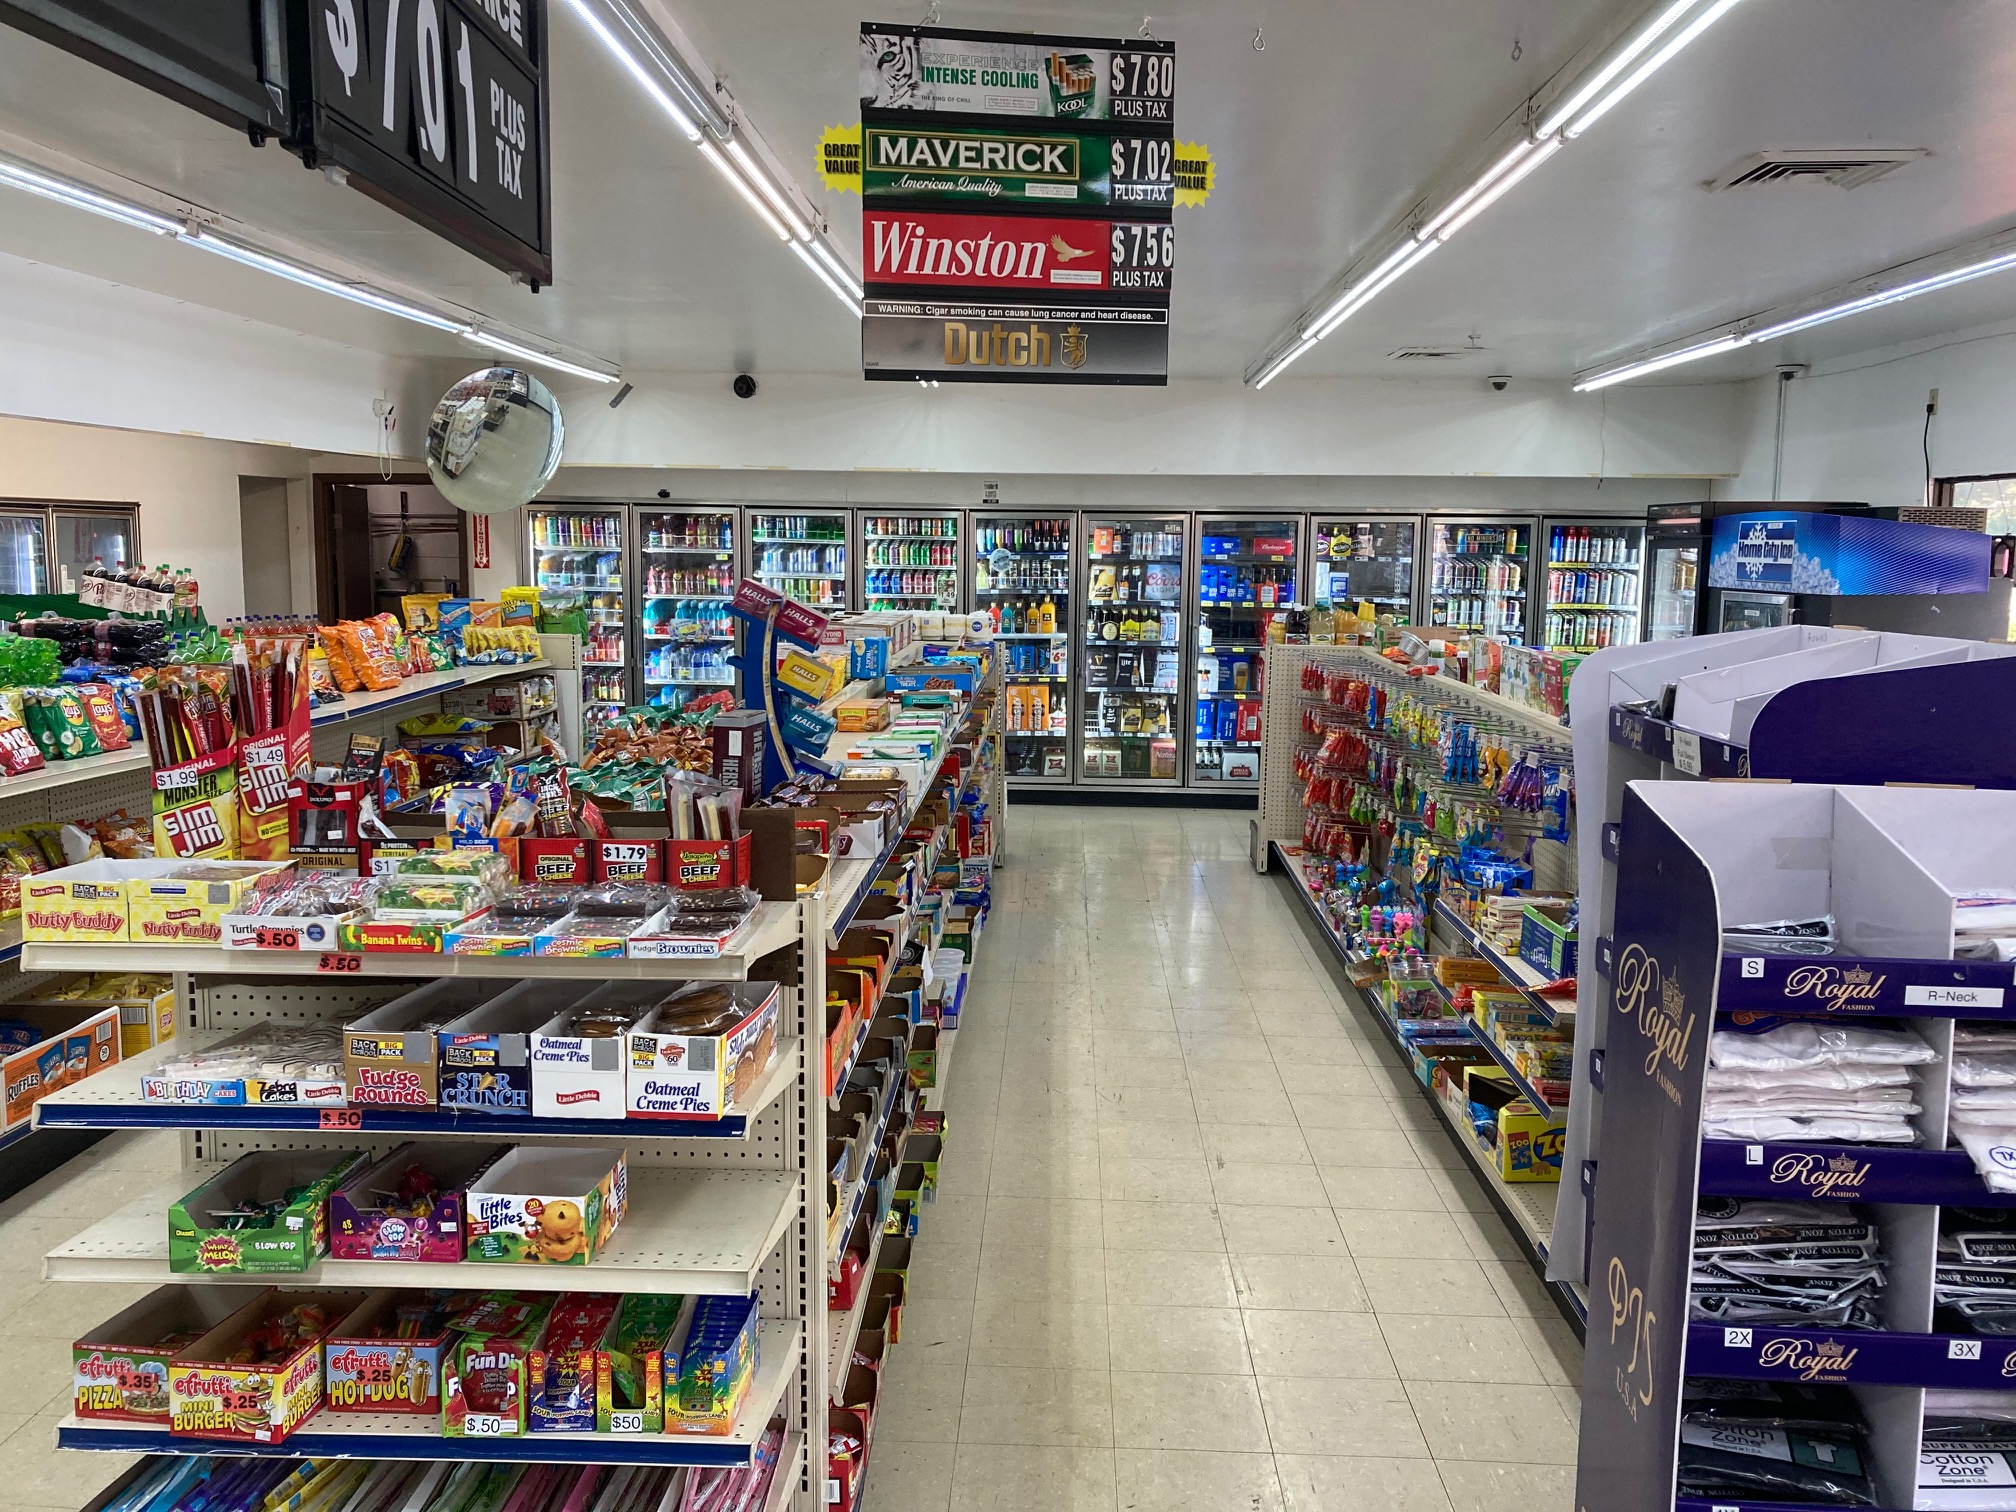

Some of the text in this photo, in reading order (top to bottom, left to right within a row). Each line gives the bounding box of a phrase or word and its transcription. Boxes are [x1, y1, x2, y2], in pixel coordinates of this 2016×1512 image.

[921, 52, 1038, 70] EXPERIENCE
[921, 66, 1039, 89] INTENSE COOLING
[1111, 53, 1173, 98] $7.80
[1057, 99, 1087, 113] KOOL
[1114, 101, 1167, 118] PLUS TAX
[490, 78, 526, 151] PLUS
[824, 144, 859, 158] GREAT
[878, 136, 1068, 174] MAVERICK
[495, 136, 523, 200] TAX
[825, 159, 860, 174] VALUE
[1112, 139, 1171, 181] $7.02
[1174, 160, 1208, 175] GREAT
[891, 174, 1003, 196] American Quality
[1174, 175, 1207, 190] VALUE
[1115, 185, 1167, 201] PLUS TAX
[871, 221, 1047, 279] Winston
[1112, 227, 1174, 267] $7.56
[1113, 271, 1140, 287] PLUS
[1142, 271, 1164, 287] TAX
[878, 304, 1153, 321] WARNING: Cigar smoking can cause lung cancer and heart disease.
[944, 322, 1051, 367] Dutch
[1738, 541, 1793, 562] Home City Ice
[741, 586, 772, 606] HALLS
[784, 608, 814, 627] HALLS
[792, 665, 817, 681] HALLS
[92, 705, 113, 716] Lay's
[790, 714, 822, 732] HALLS
[243, 733, 287, 751] ORIGINAL
[246, 750, 283, 763] $1.49
[1679, 759, 1693, 773] $5.99
[157, 771, 198, 787] $1.99
[239, 765, 287, 793] slim
[164, 775, 217, 807] MONSTER
[206, 789, 224, 799] SIZE
[253, 782, 288, 813] jim
[164, 806, 218, 837] slim
[180, 824, 224, 858] jim
[603, 846, 646, 859] $1.79
[302, 857, 346, 866] ORIGINAL
[536, 863, 576, 876] BEEF
[545, 873, 573, 882] CHEESE
[607, 863, 647, 877] BEEF
[680, 864, 719, 877] BEEF
[688, 874, 717, 884] CHEESE
[74, 884, 95, 893] BACK
[27, 911, 125, 934] Nutty Buddy
[230, 924, 256, 934] Turtle
[143, 922, 222, 941] Nutty Buddy
[256, 932, 297, 947] $.50
[361, 932, 422, 946] Banana Twins
[453, 942, 497, 955] Brownies
[545, 943, 590, 955] Brownies
[633, 942, 714, 955] Fudge Brownies
[320, 957, 361, 971] $.50
[1747, 960, 1759, 976] S
[1784, 965, 1887, 1012] Royal
[1928, 989, 1978, 1003] R-Neck
[1616, 942, 1697, 1077] Royal
[1842, 1003, 1876, 1012] FASHION
[352, 1038, 376, 1051] BACK
[540, 1037, 582, 1050] Oatmeal
[533, 1049, 590, 1063] Creme Pies
[359, 1067, 420, 1088] Fudge
[7, 1074, 39, 1104] RUFFLES
[156, 1081, 212, 1099] BIRTHDAY
[213, 1089, 236, 1098] CAKES
[257, 1081, 297, 1093] Zebra
[644, 1080, 701, 1097] Oatmeal
[1656, 1068, 1683, 1108] FASHION
[262, 1091, 296, 1102] Cakes
[353, 1085, 428, 1107] Rounds
[442, 1087, 527, 1107] CRUNCH
[636, 1095, 710, 1111] Creme Pies
[1748, 1148, 1759, 1164] L
[480, 1198, 511, 1220] Little
[528, 1200, 539, 1209] 20
[490, 1212, 522, 1230] Bites
[207, 1243, 227, 1252] WHAT
[255, 1241, 296, 1250] BLOW POP
[204, 1250, 238, 1260] MELON
[1728, 1330, 1751, 1346] 2X
[1953, 1343, 1976, 1357] 3X
[78, 1353, 134, 1380] efrutti
[466, 1354, 496, 1373] Fun
[119, 1375, 152, 1389] $.35
[173, 1370, 234, 1398] efrutti
[356, 1369, 391, 1383] $.25
[370, 1374, 409, 1402] DOG
[78, 1385, 123, 1411] PIZZA
[222, 1395, 258, 1409] $.25
[180, 1401, 214, 1413] MINI
[532, 1406, 550, 1418] SOUR
[667, 1407, 685, 1420] SOUR
[173, 1412, 234, 1432] BURGER
[467, 1418, 500, 1432] $.50
[612, 1416, 641, 1430] $50
[1920, 1453, 1994, 1466] Cotton
[1935, 1465, 1985, 1476] Zone
